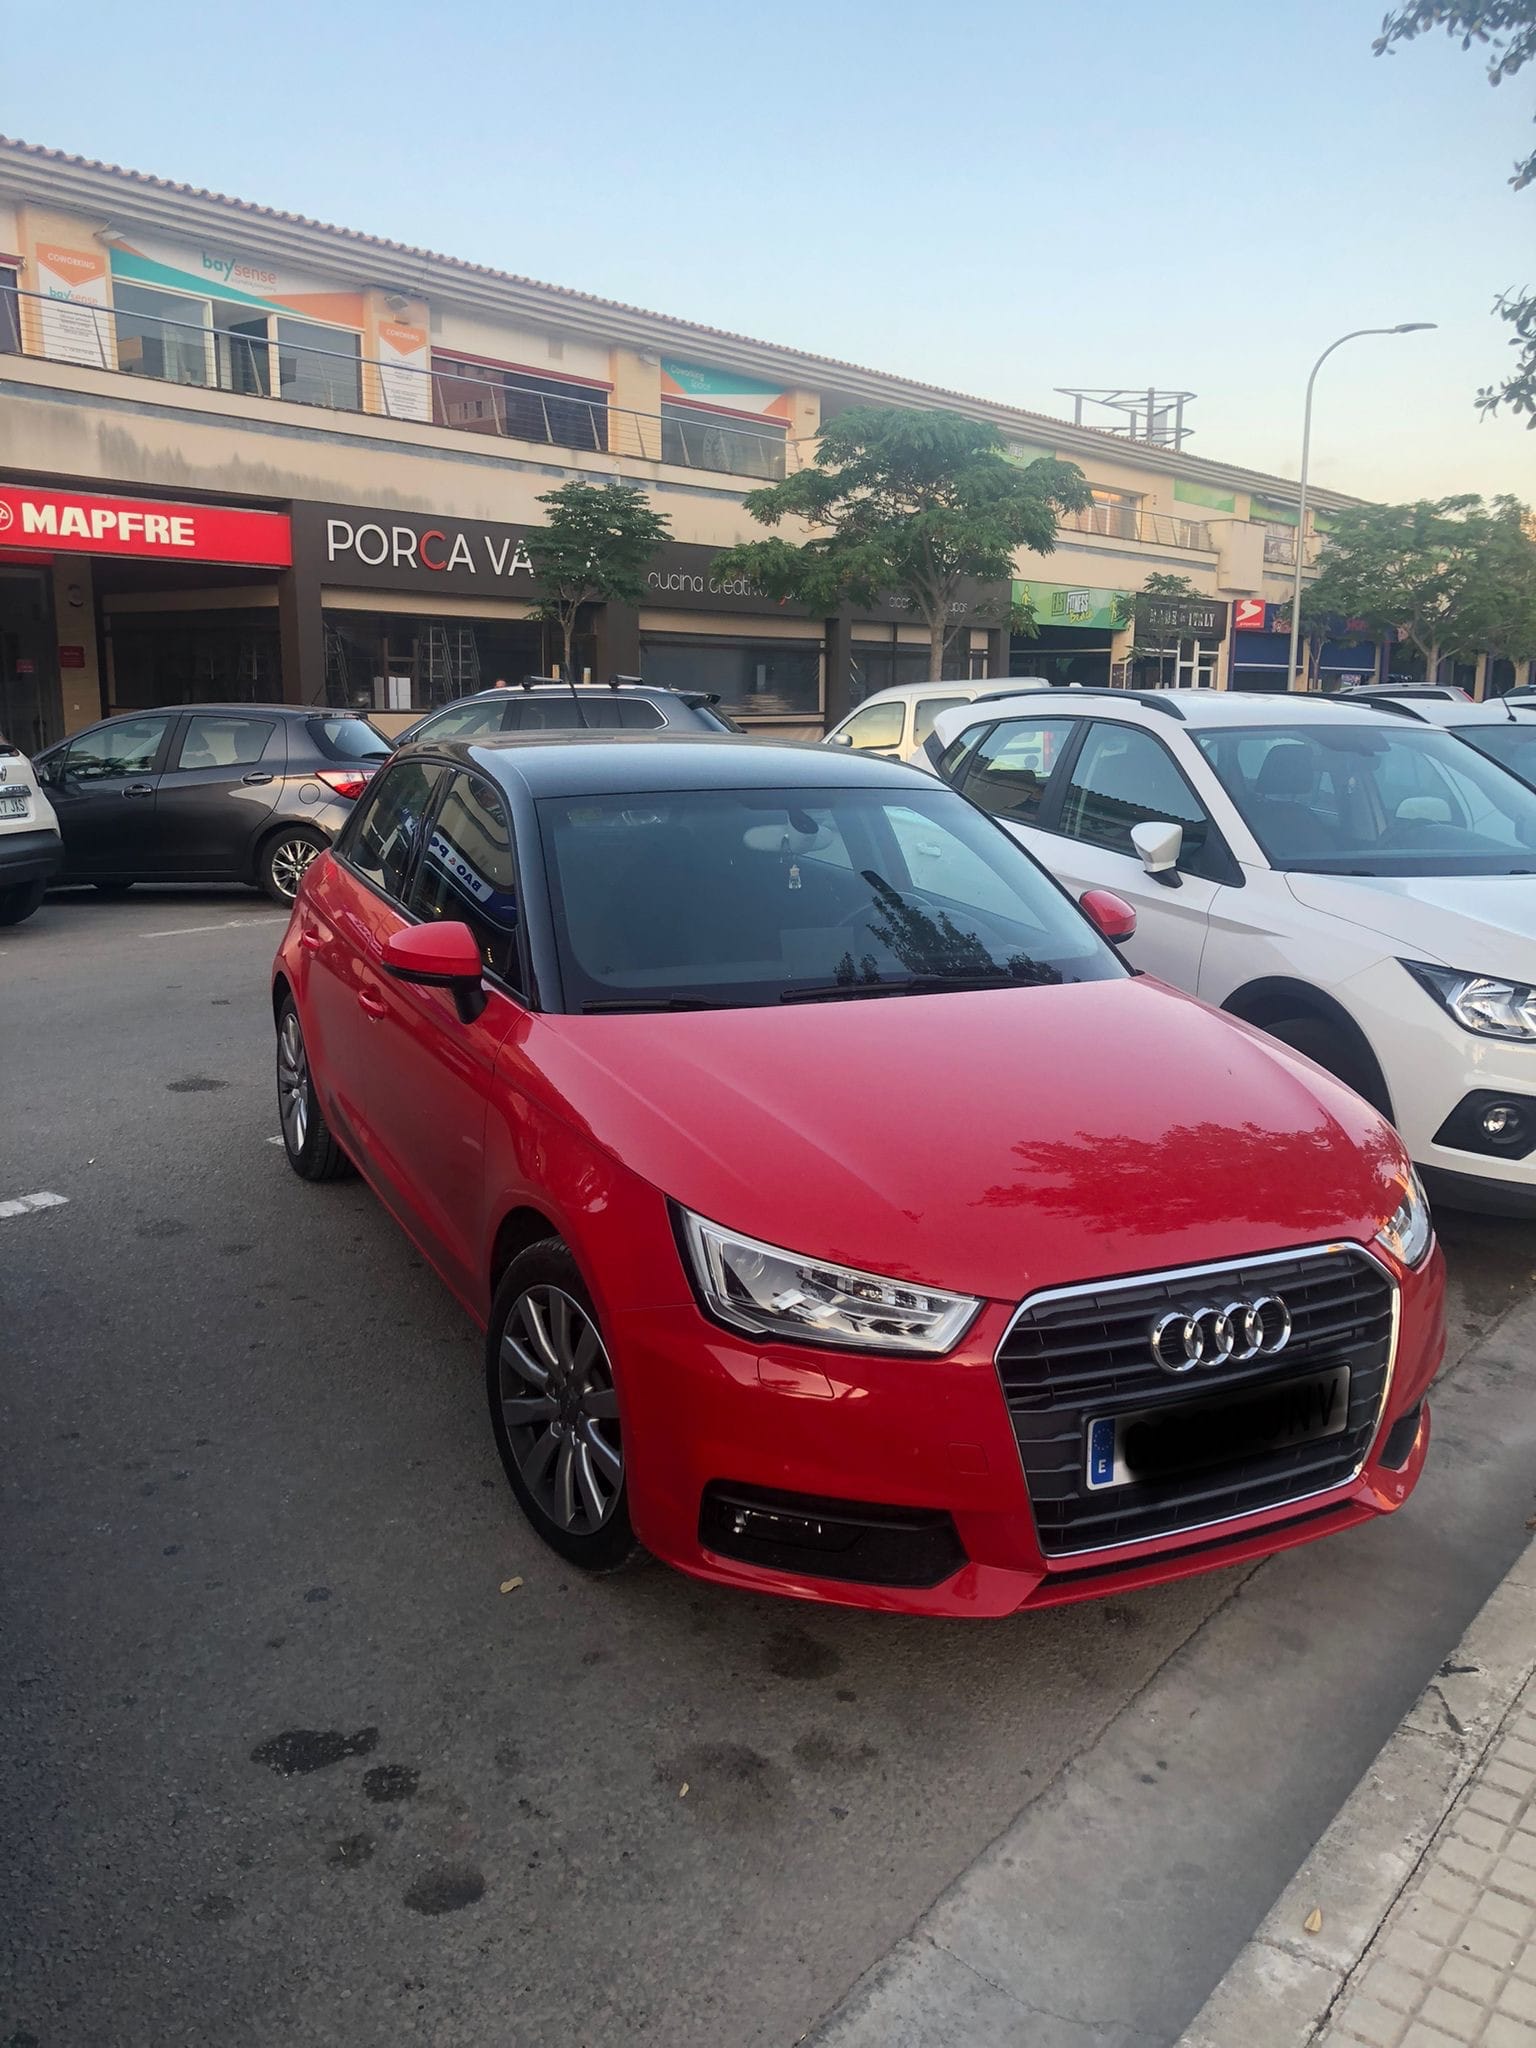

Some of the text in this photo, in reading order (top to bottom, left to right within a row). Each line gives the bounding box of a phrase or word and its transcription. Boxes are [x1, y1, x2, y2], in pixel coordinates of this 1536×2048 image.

[46, 252, 97, 270] COWORKING
[202, 250, 278, 285] baysense
[21, 502, 196, 546] MAPFRE
[326, 519, 477, 575] PORCA
[647, 567, 704, 592] cucina
[1188, 612, 1215, 627] ITALY
[11, 799, 25, 812] JXS
[1097, 1459, 1107, 1474] E
